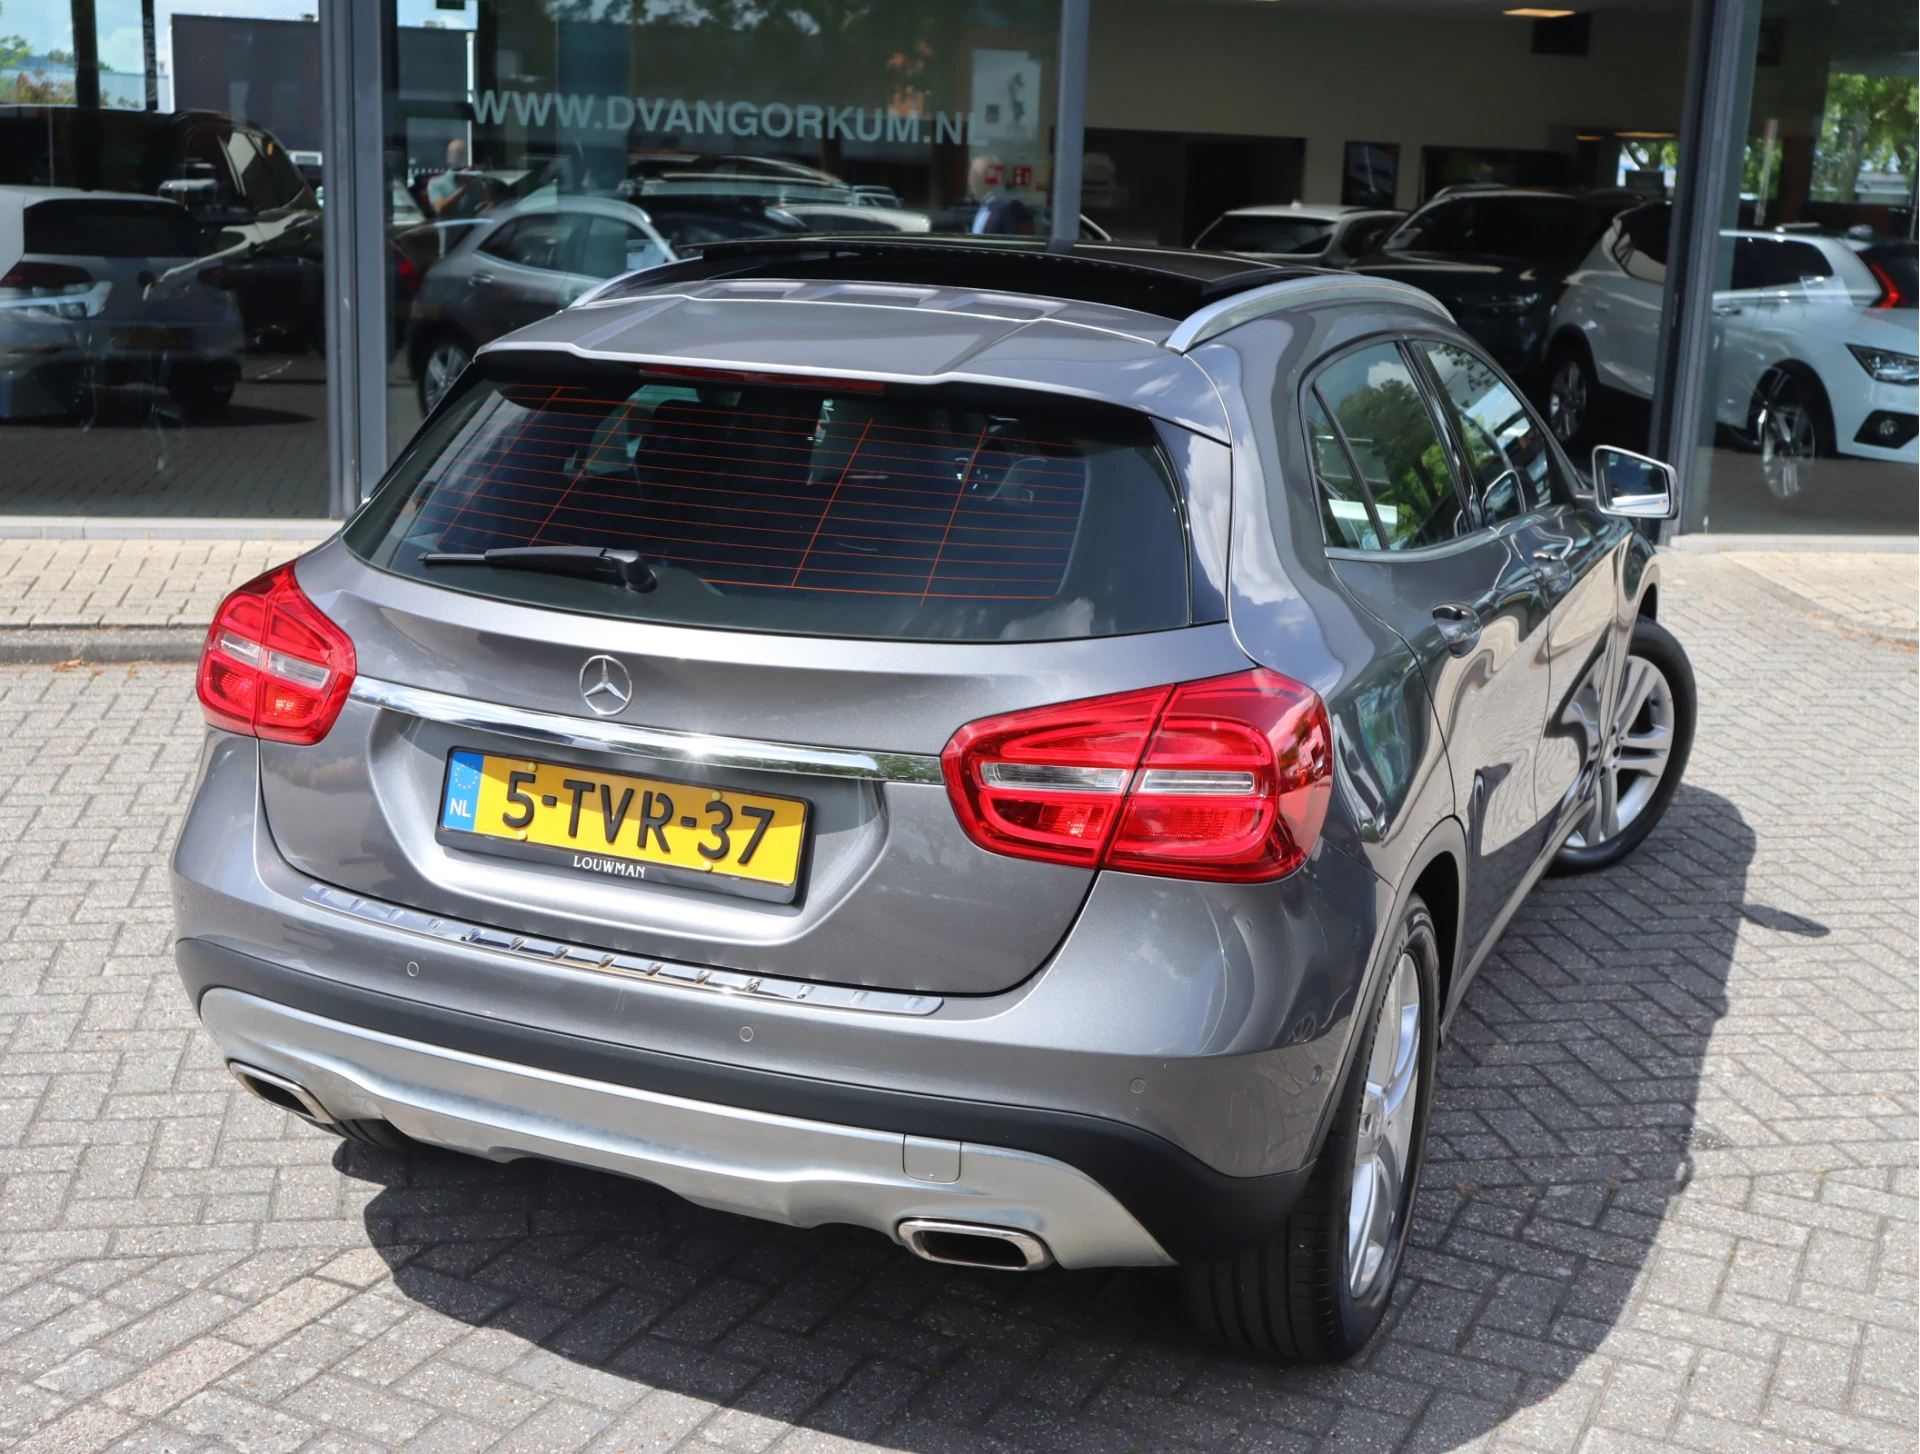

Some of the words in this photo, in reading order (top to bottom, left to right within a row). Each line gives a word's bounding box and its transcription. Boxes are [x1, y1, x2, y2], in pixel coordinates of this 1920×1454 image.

[470, 89, 989, 146] WWW.DVANGORKUM.NL
[449, 798, 472, 818] NL
[502, 770, 775, 865] 5-TVR-37
[573, 855, 646, 879] LOUWMAN
